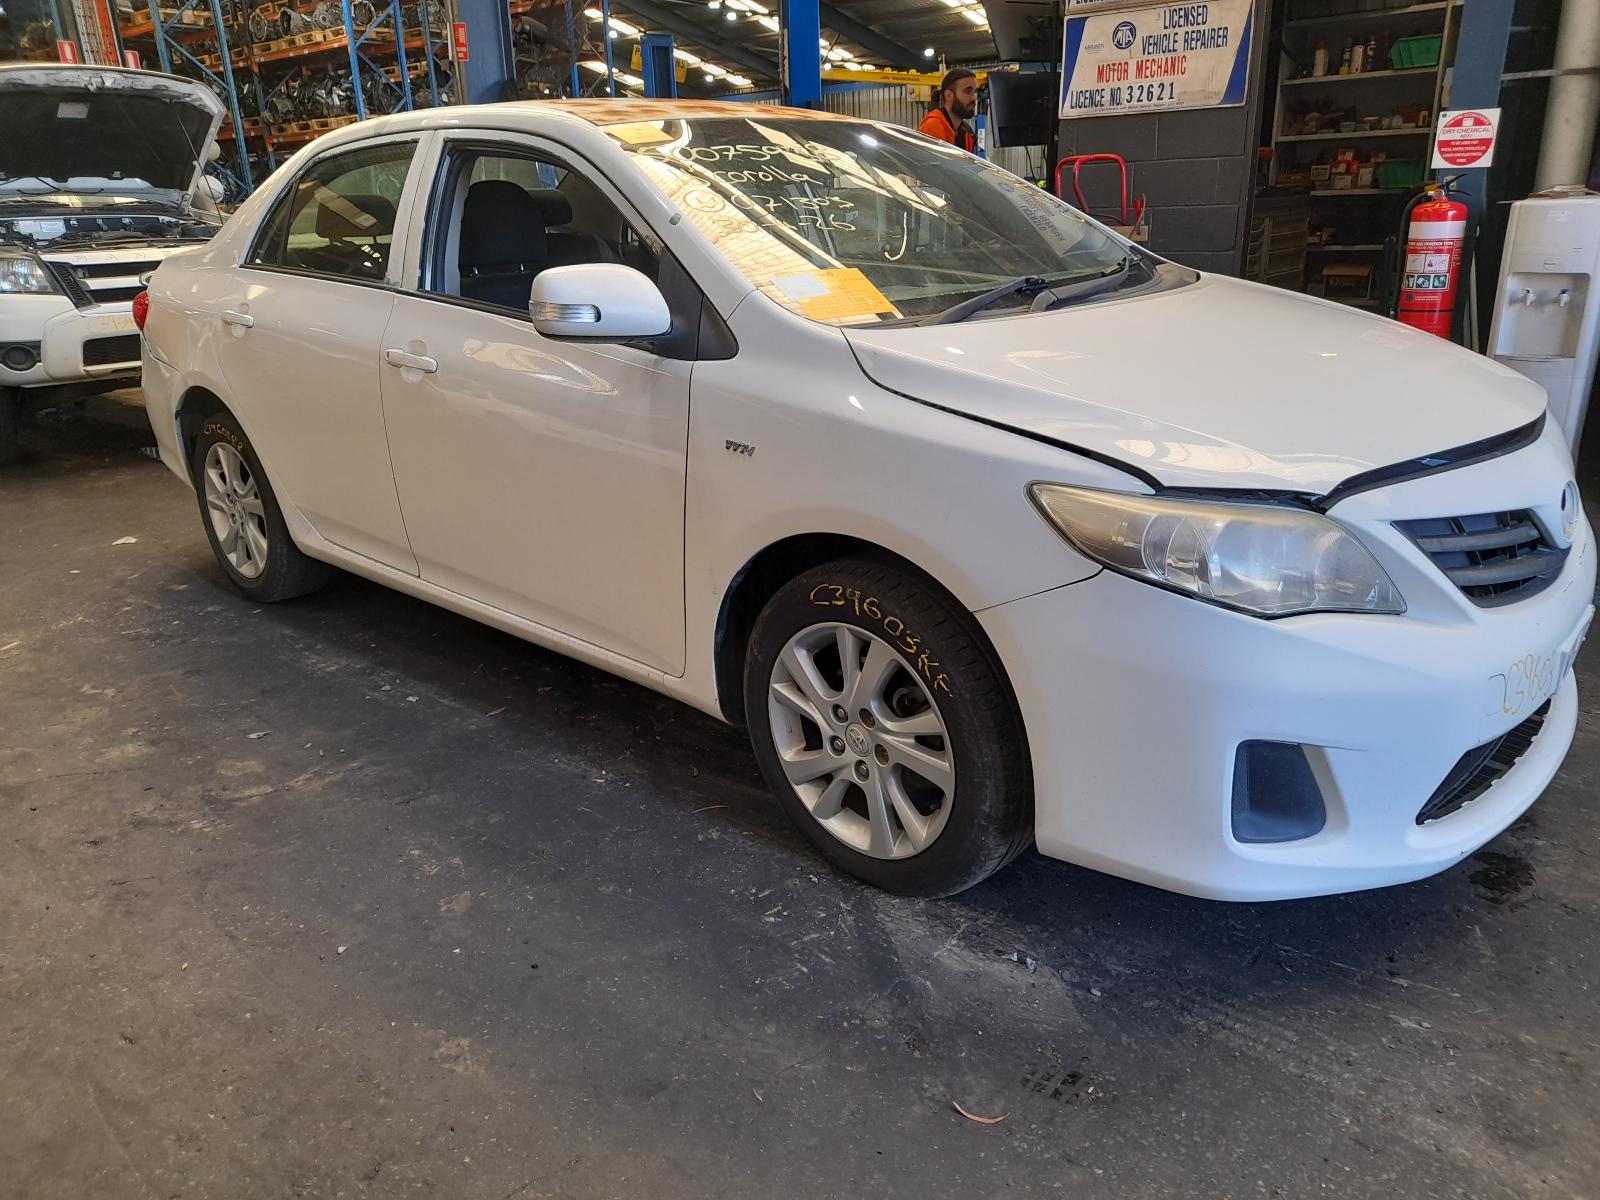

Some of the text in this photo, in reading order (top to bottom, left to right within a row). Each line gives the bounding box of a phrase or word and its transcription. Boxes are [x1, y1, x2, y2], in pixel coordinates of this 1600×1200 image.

[1163, 4, 1208, 30] LICENSED
[1142, 26, 1229, 56] VEHICLE REPAIRER
[1096, 55, 1187, 84] MOTOR MECHANIC
[1070, 88, 1106, 110] LICENCE
[1109, 87, 1122, 106] NO.
[1126, 82, 1175, 104] 32621
